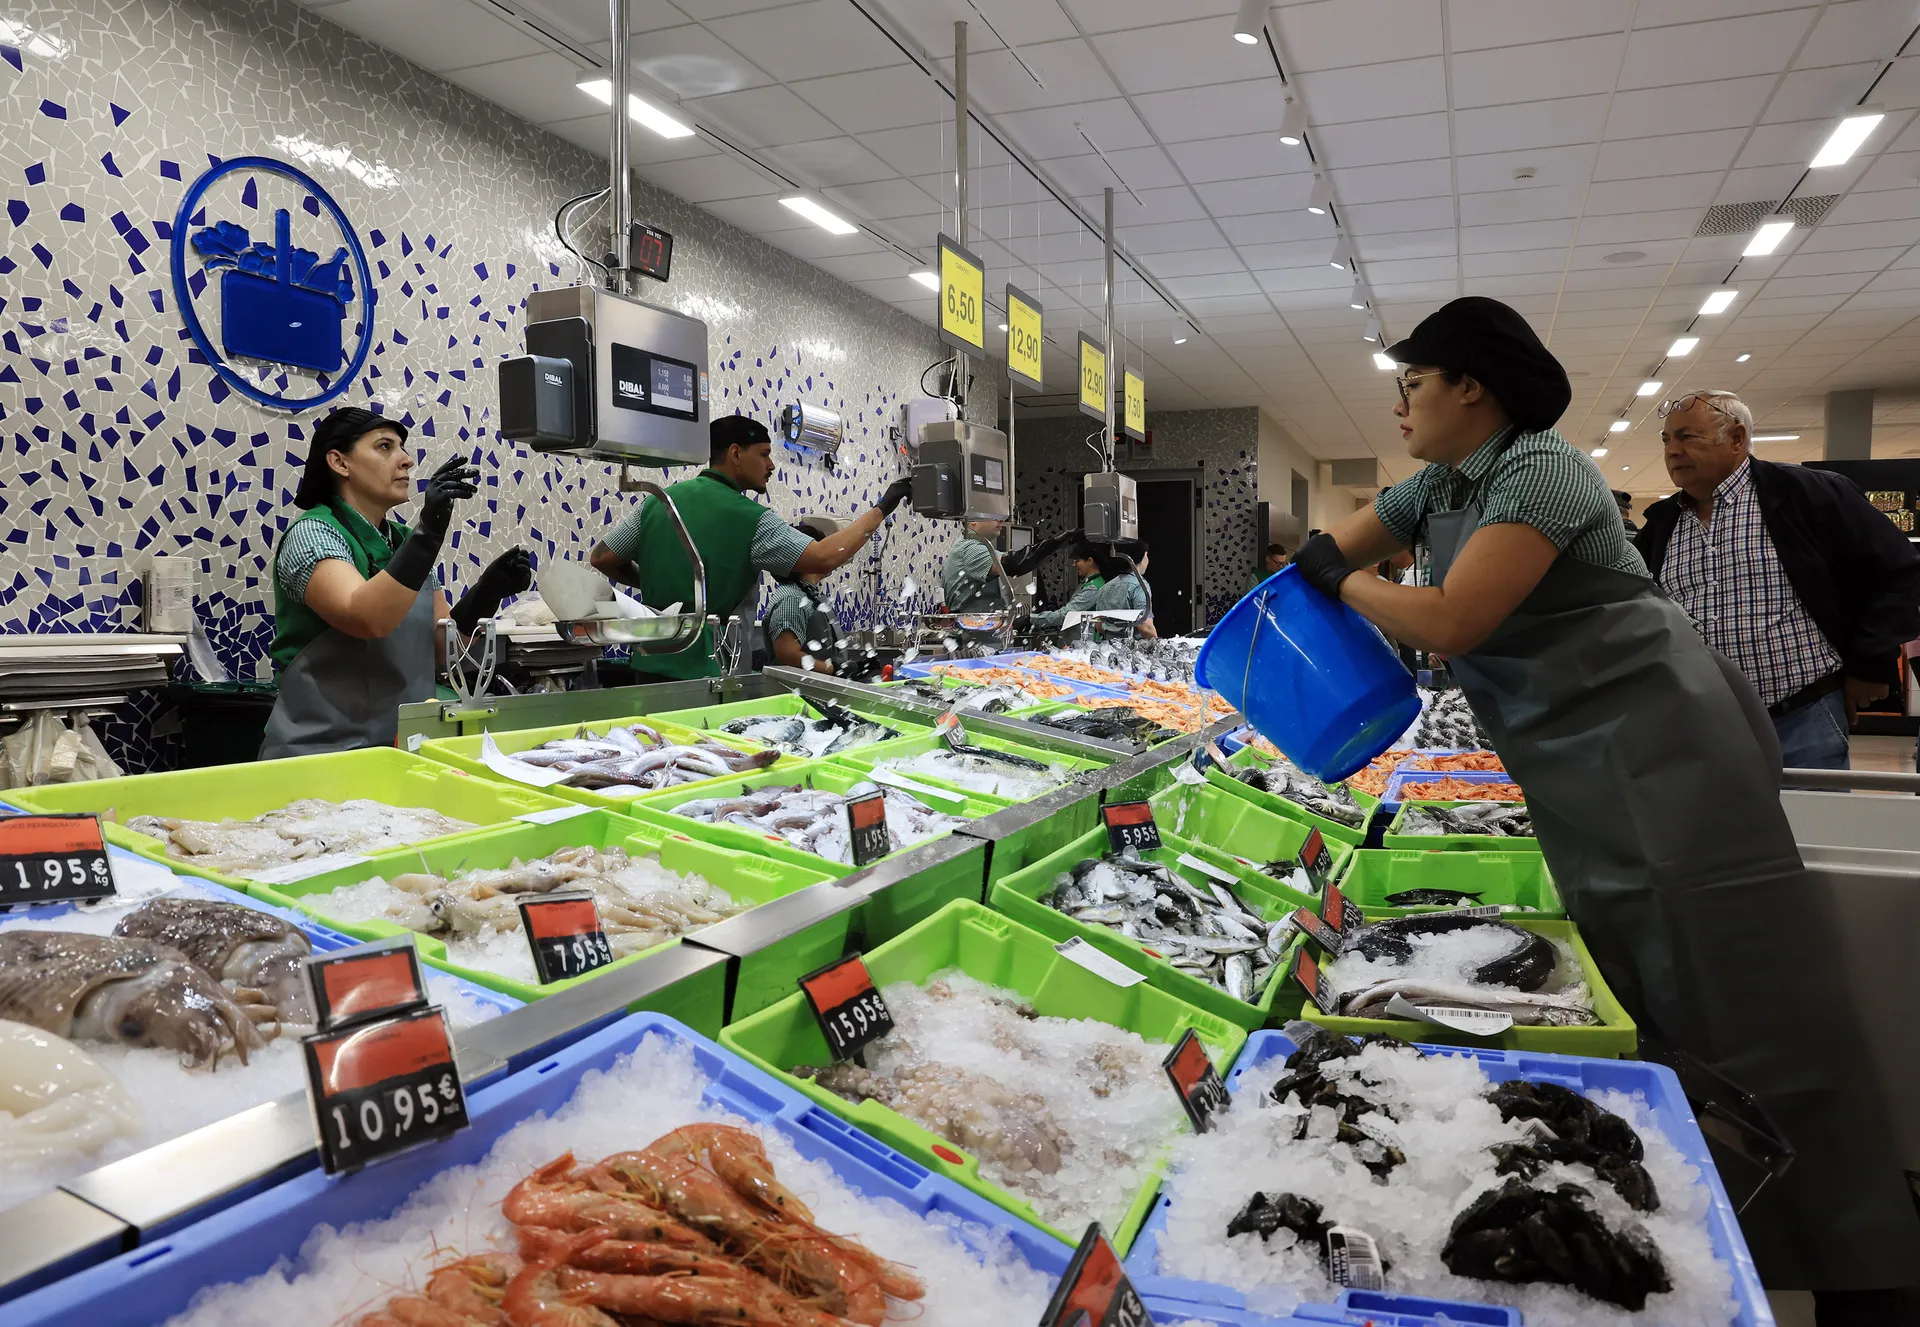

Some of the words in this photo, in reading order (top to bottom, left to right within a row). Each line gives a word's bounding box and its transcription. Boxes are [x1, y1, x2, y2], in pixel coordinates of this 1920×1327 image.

[640, 234, 664, 267] 07
[948, 283, 975, 325] 6,50
[1011, 324, 1039, 363] 12,90
[544, 372, 563, 384] DIBAL
[618, 380, 645, 395] DIBAL
[1083, 366, 1104, 397] 12,90
[1127, 394, 1141, 420] 7,50
[1122, 826, 1150, 845] 5,95
[0, 858, 87, 890] 1,95
[94, 874, 109, 887] kg
[553, 938, 599, 973] 7,95
[600, 951, 612, 963] kg
[829, 997, 877, 1048] 15,95
[331, 1082, 440, 1149] 10,95
